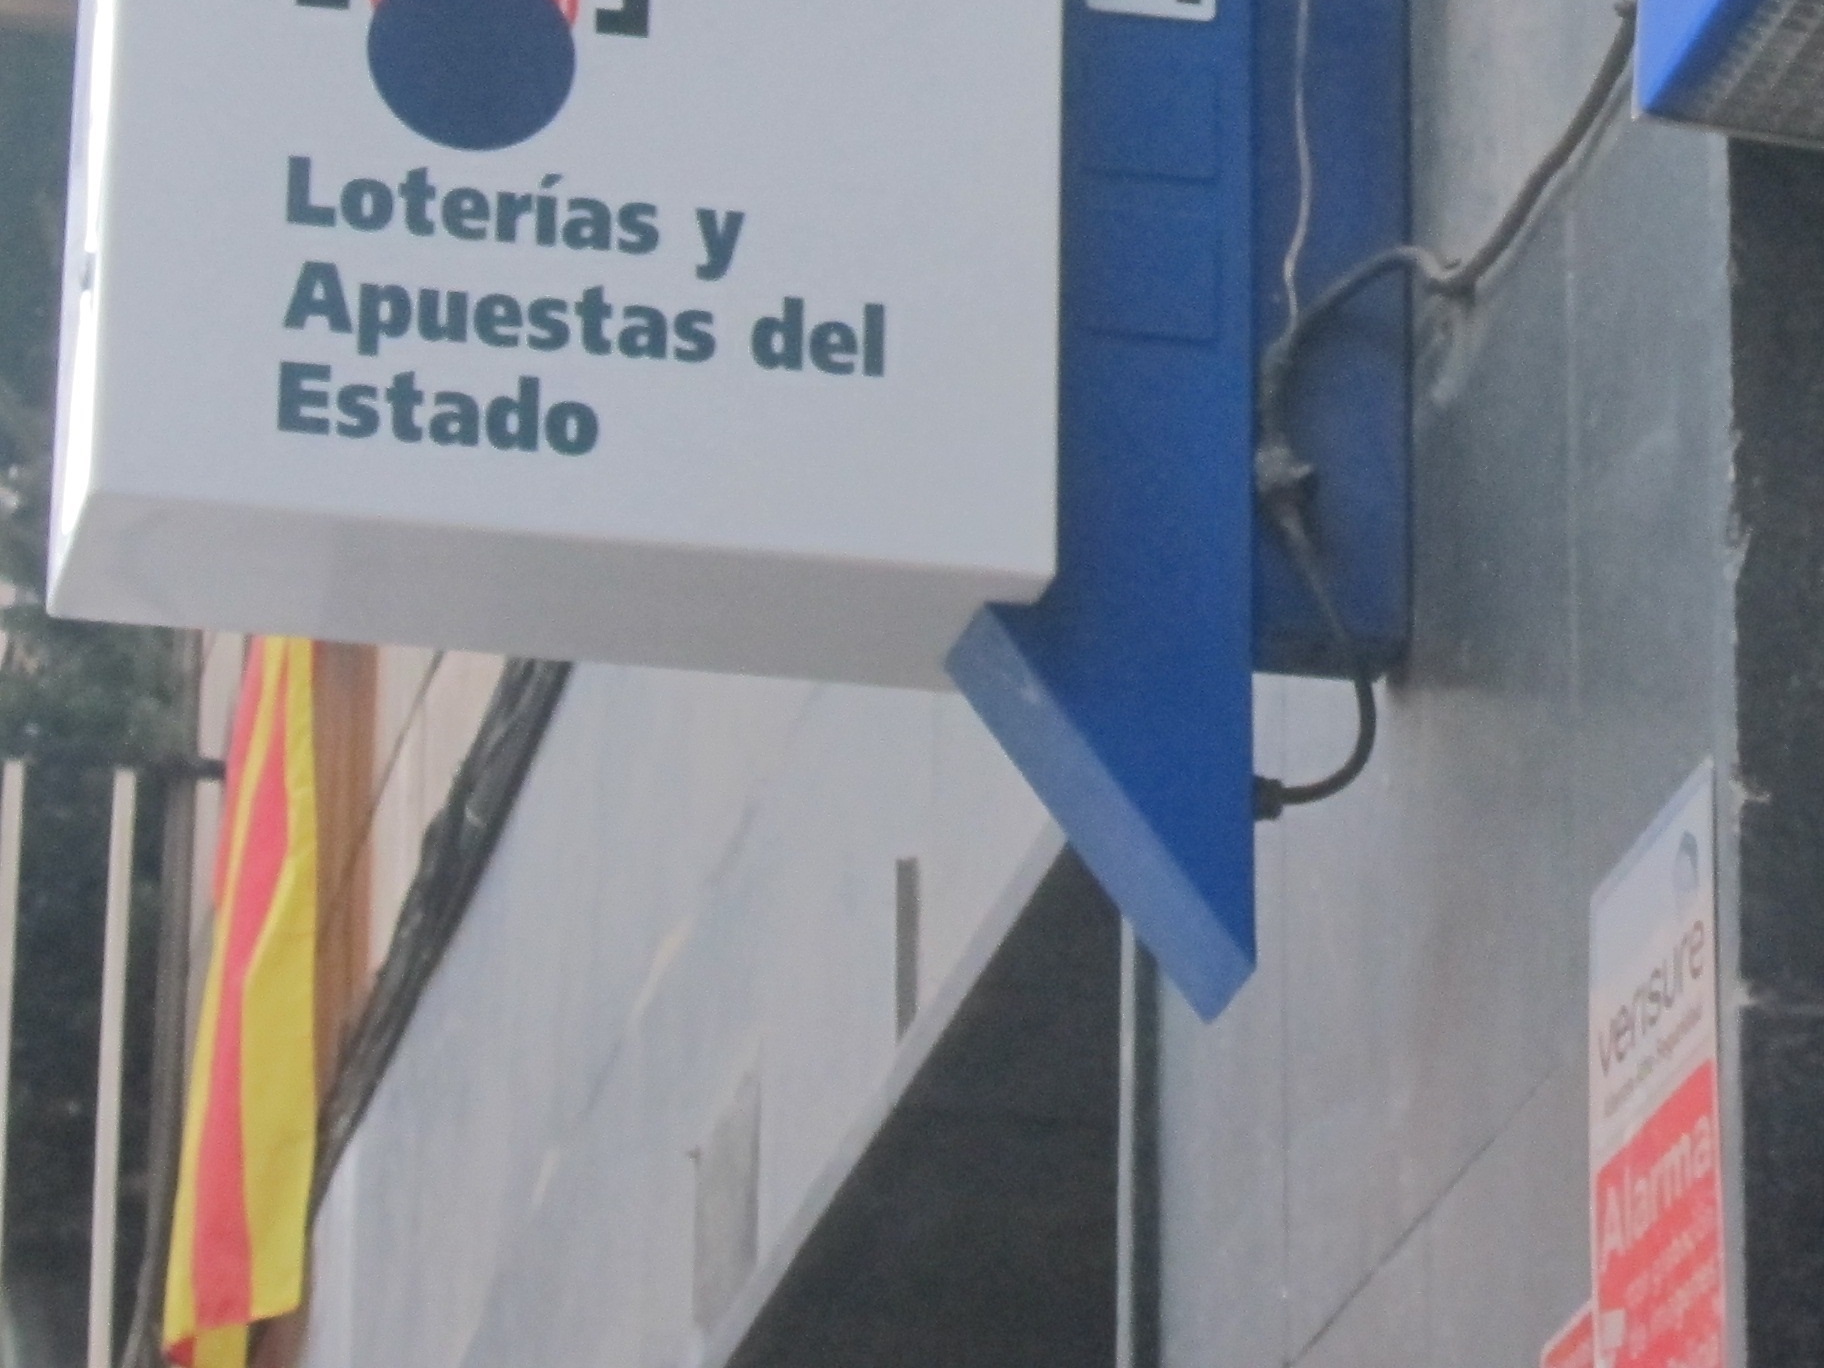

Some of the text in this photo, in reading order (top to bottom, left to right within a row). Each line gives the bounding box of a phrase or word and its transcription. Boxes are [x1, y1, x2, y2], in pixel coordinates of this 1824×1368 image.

[284, 154, 746, 282] Loterías y
[282, 259, 887, 378] Apuestas del
[276, 360, 600, 457] Estado
